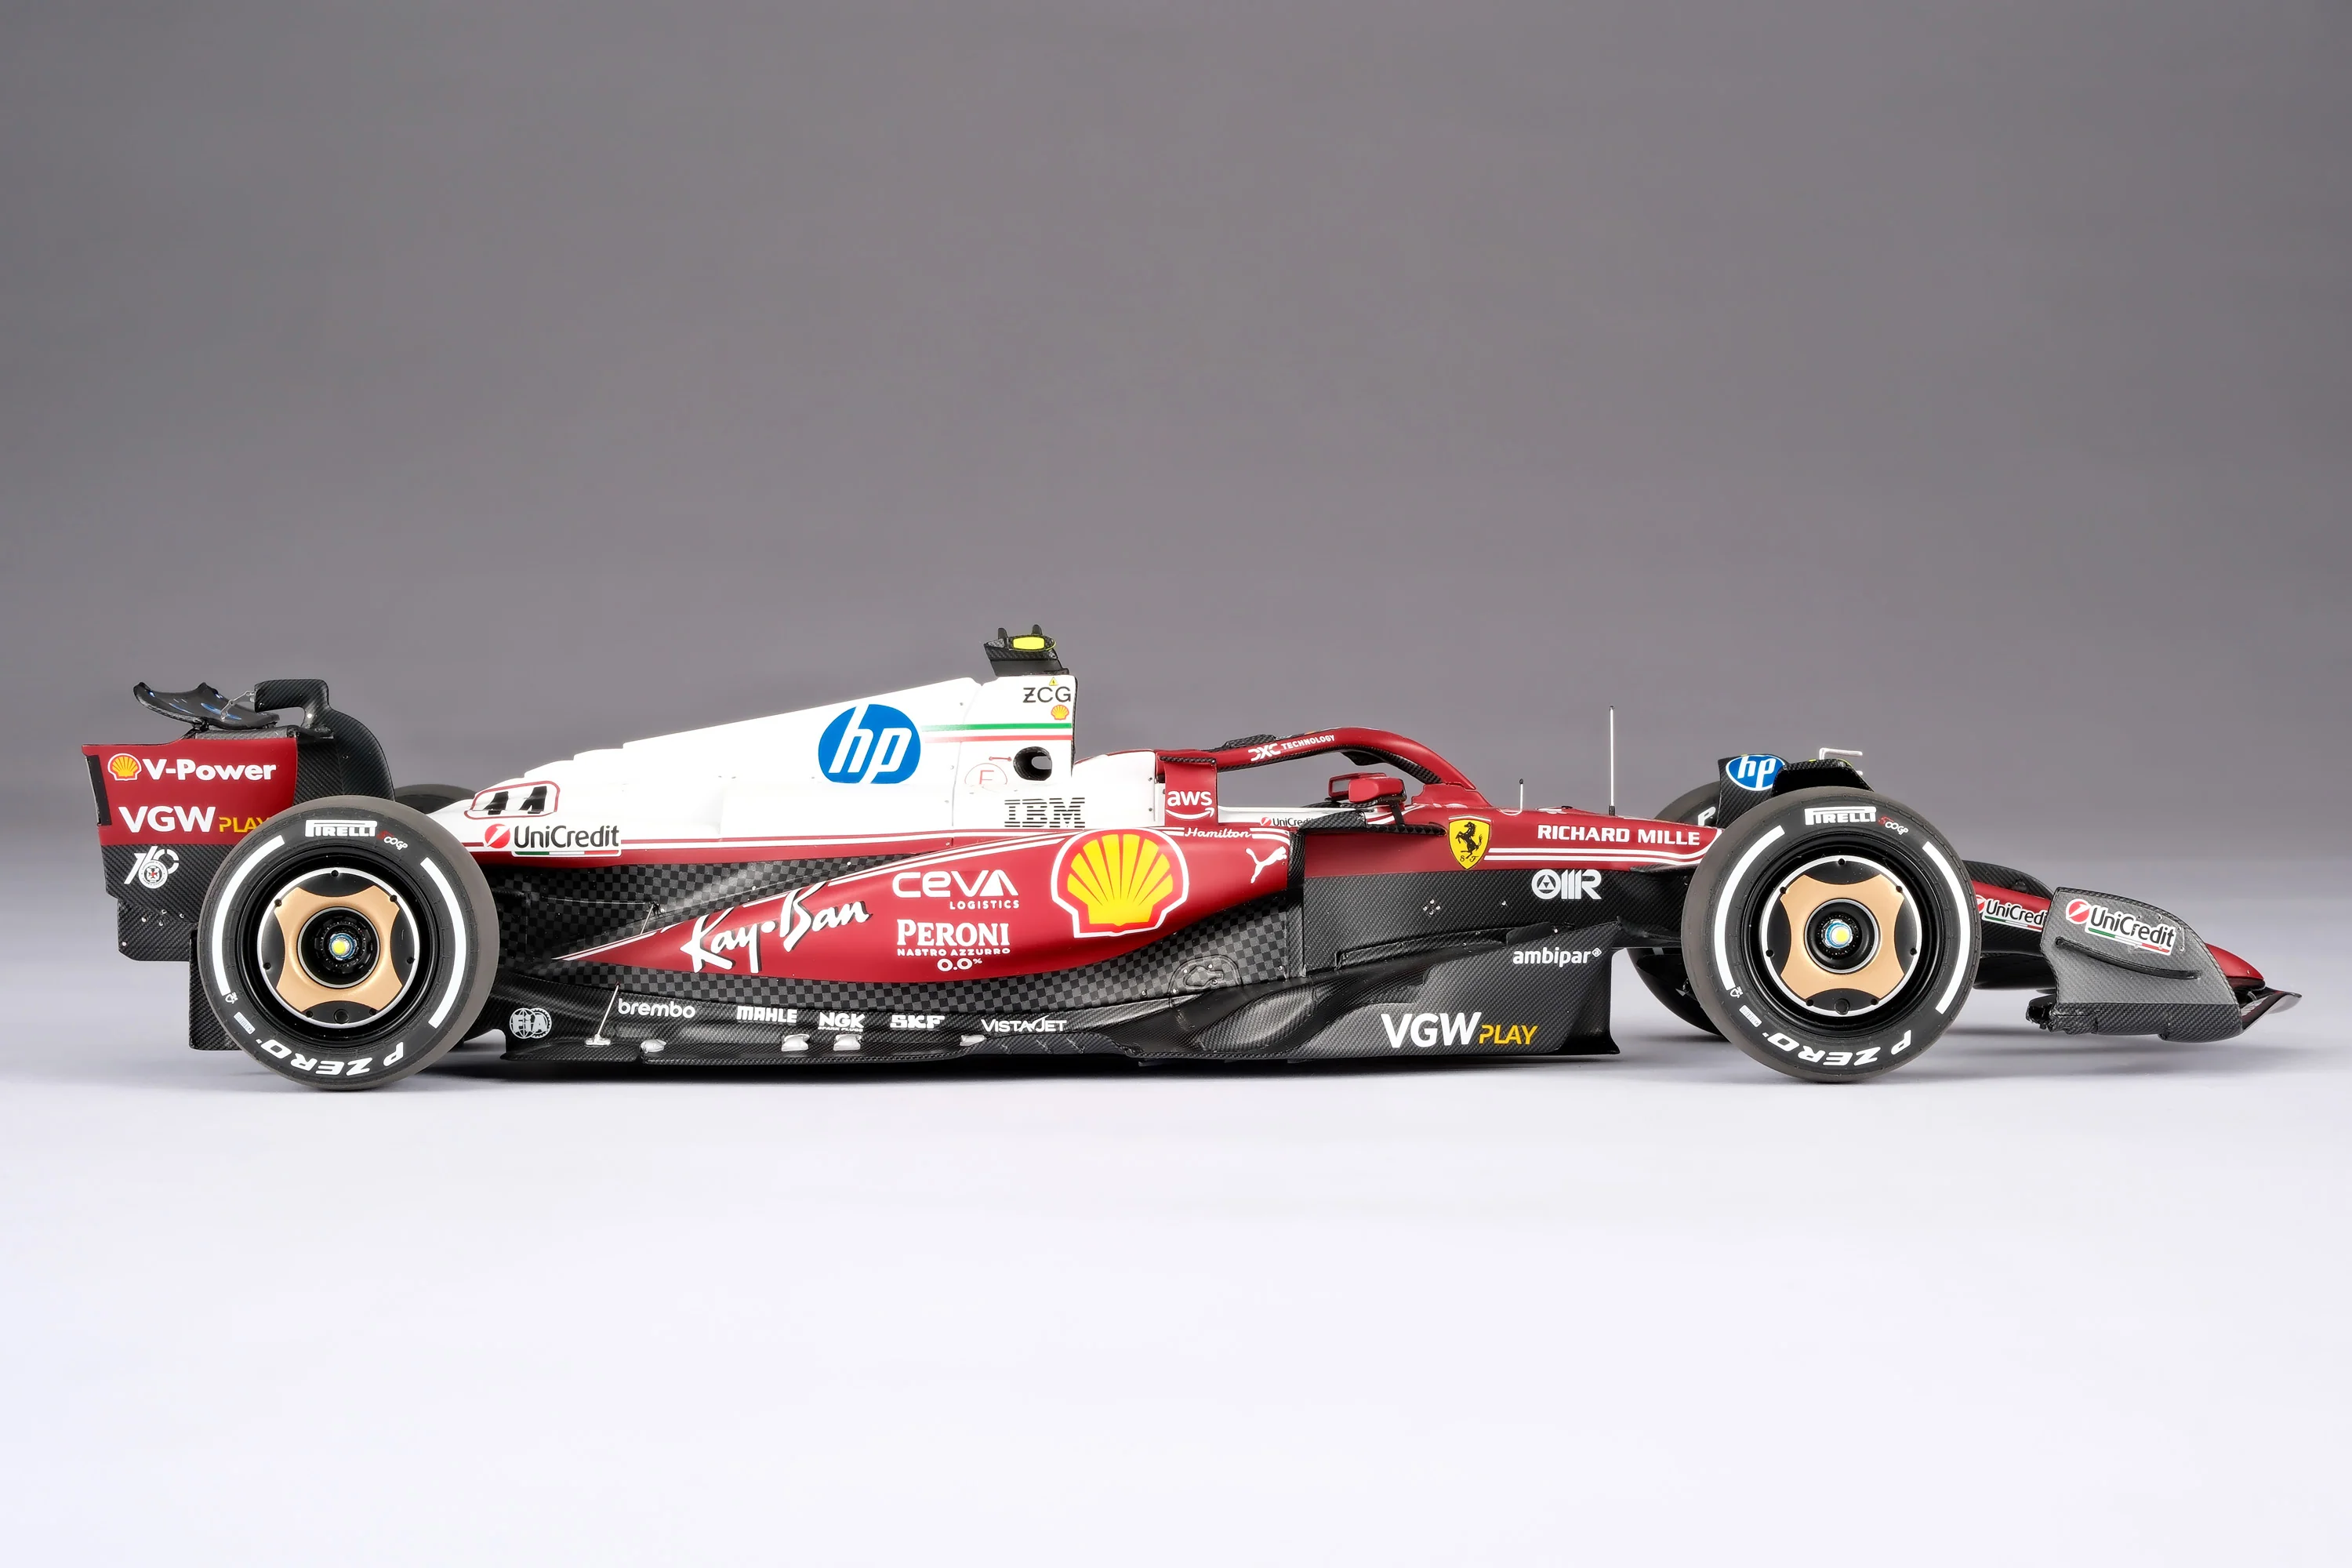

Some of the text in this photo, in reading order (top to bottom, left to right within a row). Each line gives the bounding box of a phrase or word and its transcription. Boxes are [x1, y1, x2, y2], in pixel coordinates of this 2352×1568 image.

[828, 706, 912, 785] hp
[1280, 735, 1335, 750] TECHNOLOGY
[142, 758, 277, 781] V-Power
[1737, 756, 1777, 789] hp
[1167, 790, 1213, 807] aws
[118, 806, 216, 833] VGW
[1004, 797, 1085, 828] IBM
[1804, 806, 1877, 825] PIRELLI
[305, 819, 378, 837] PIRELLI
[514, 825, 619, 848] UniCredit
[1184, 828, 1251, 838] Hamilton
[1537, 825, 1700, 846] RICHARD MILLE
[949, 899, 1020, 910] LOGISTICS
[896, 919, 1011, 947] PERONI
[2090, 906, 2176, 948] UniCredit
[897, 947, 1011, 956] NASTRO AZZURRO
[1512, 946, 1592, 968] ambipar
[618, 998, 696, 1018] brembo
[736, 1005, 798, 1023] MAHLE
[511, 1012, 550, 1034] FIA
[818, 1011, 866, 1029] NGK
[890, 1014, 946, 1029] SKF
[1381, 1011, 1539, 1048] VGW PLAY
[260, 1039, 373, 1076] ZERO
[1767, 1032, 1882, 1066] ZERO
